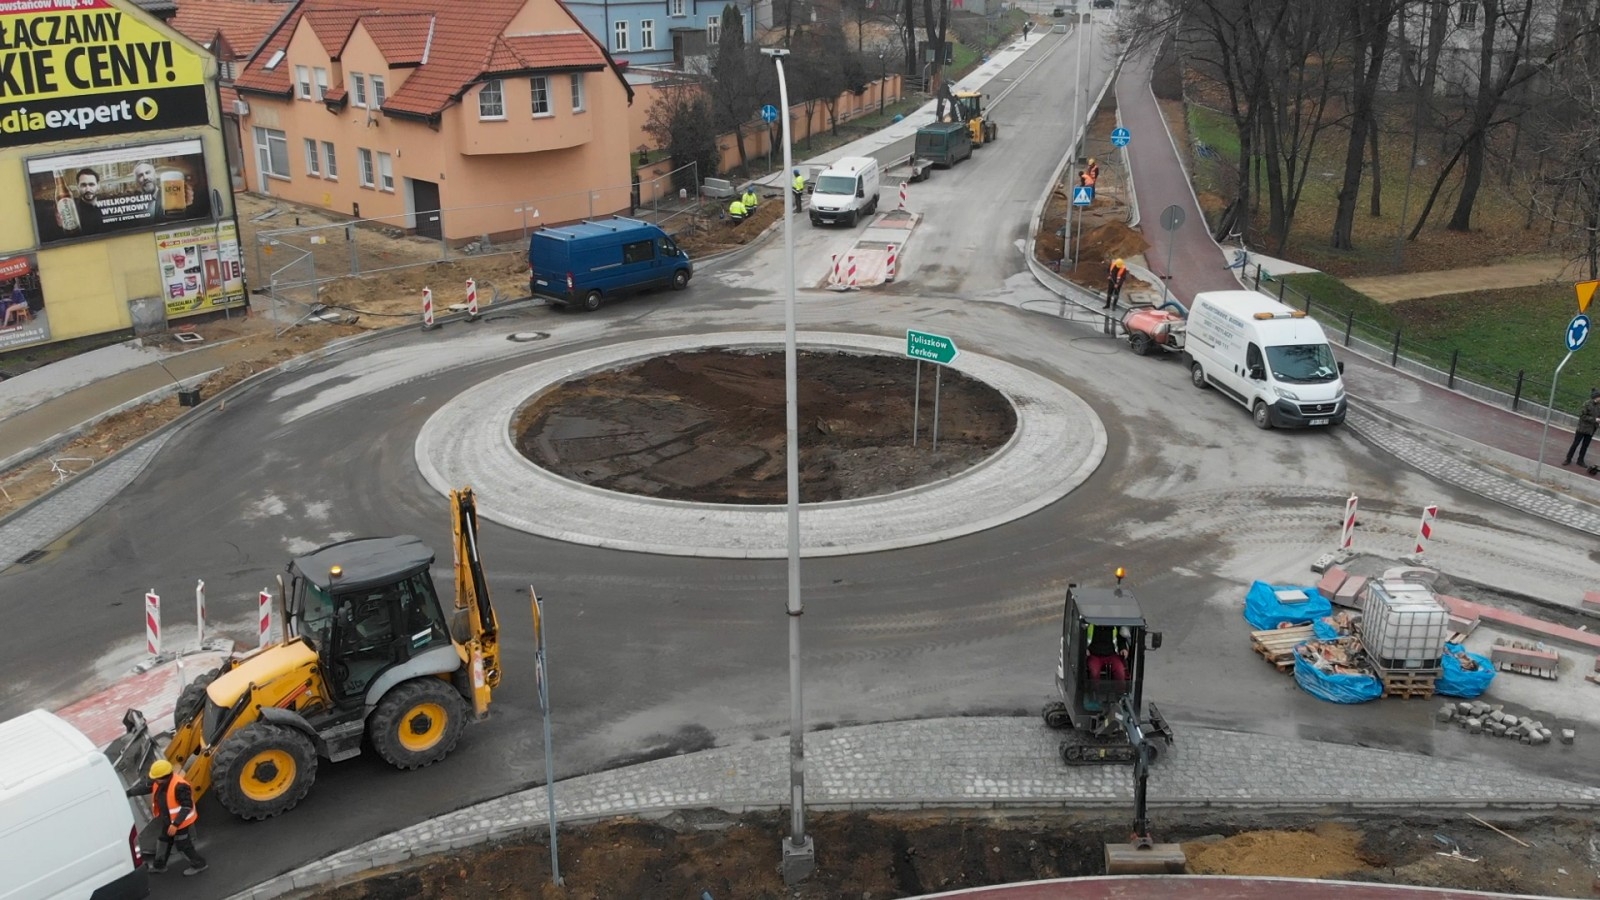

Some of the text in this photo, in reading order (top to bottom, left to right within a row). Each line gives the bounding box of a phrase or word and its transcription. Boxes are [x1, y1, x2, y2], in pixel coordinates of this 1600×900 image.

[65, 41, 176, 89] CENY!
[0, 100, 132, 134] diaexpert
[96, 194, 152, 208] WIELKOPOLSKI
[101, 203, 149, 216] WYJĄTKOWY
[910, 334, 947, 349] Tuliszków
[910, 344, 938, 359] Żerków
